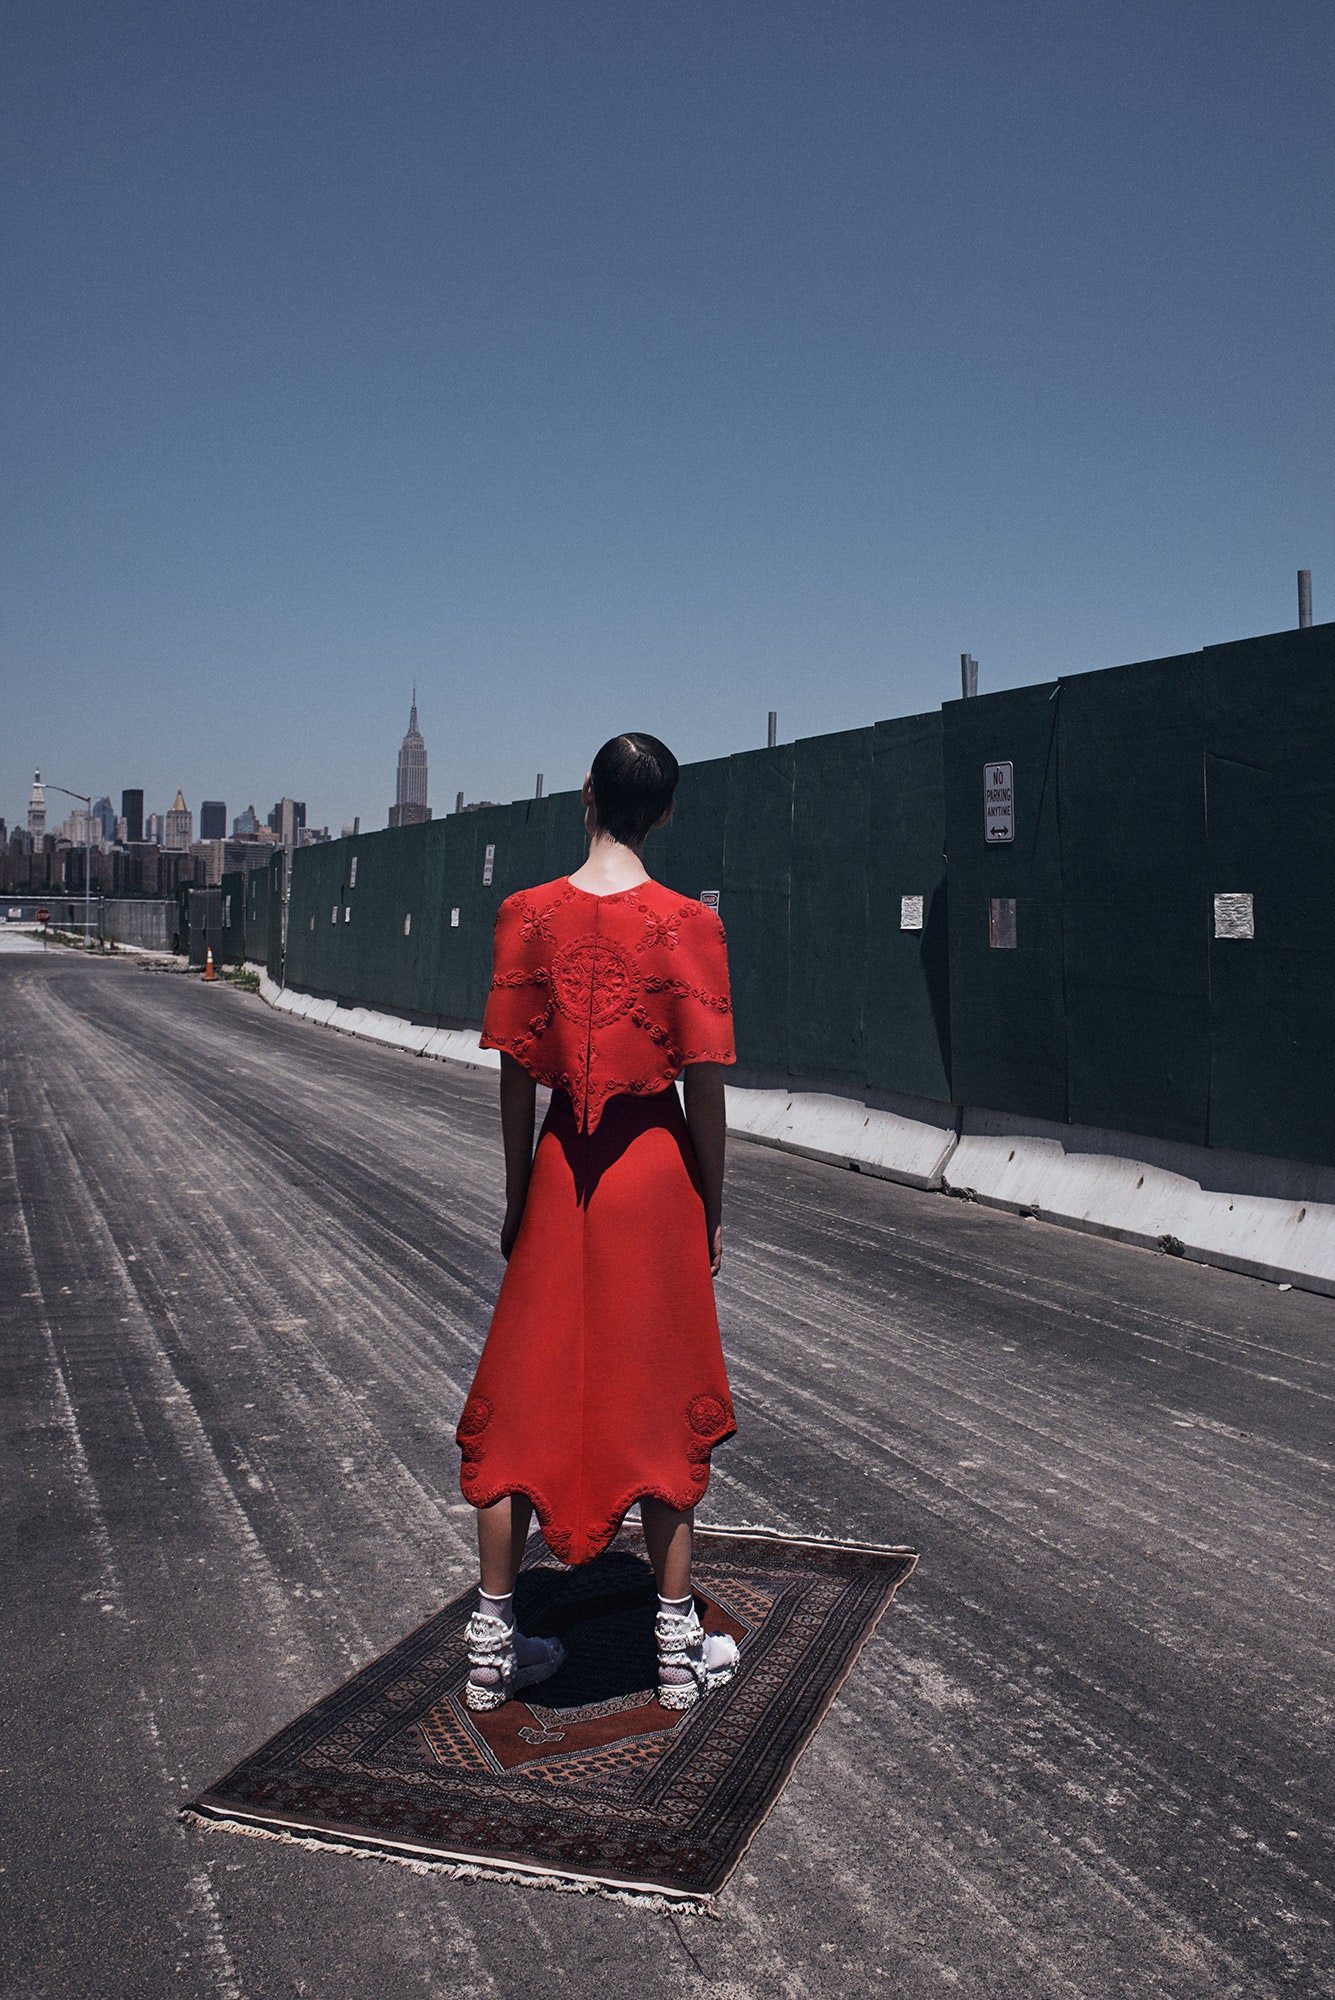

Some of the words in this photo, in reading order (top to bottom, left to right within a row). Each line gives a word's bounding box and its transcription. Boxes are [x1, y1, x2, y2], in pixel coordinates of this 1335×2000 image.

[993, 771, 1004, 785] NO
[987, 789, 1011, 803] PARKING
[987, 805, 1011, 817] ANYTIME
